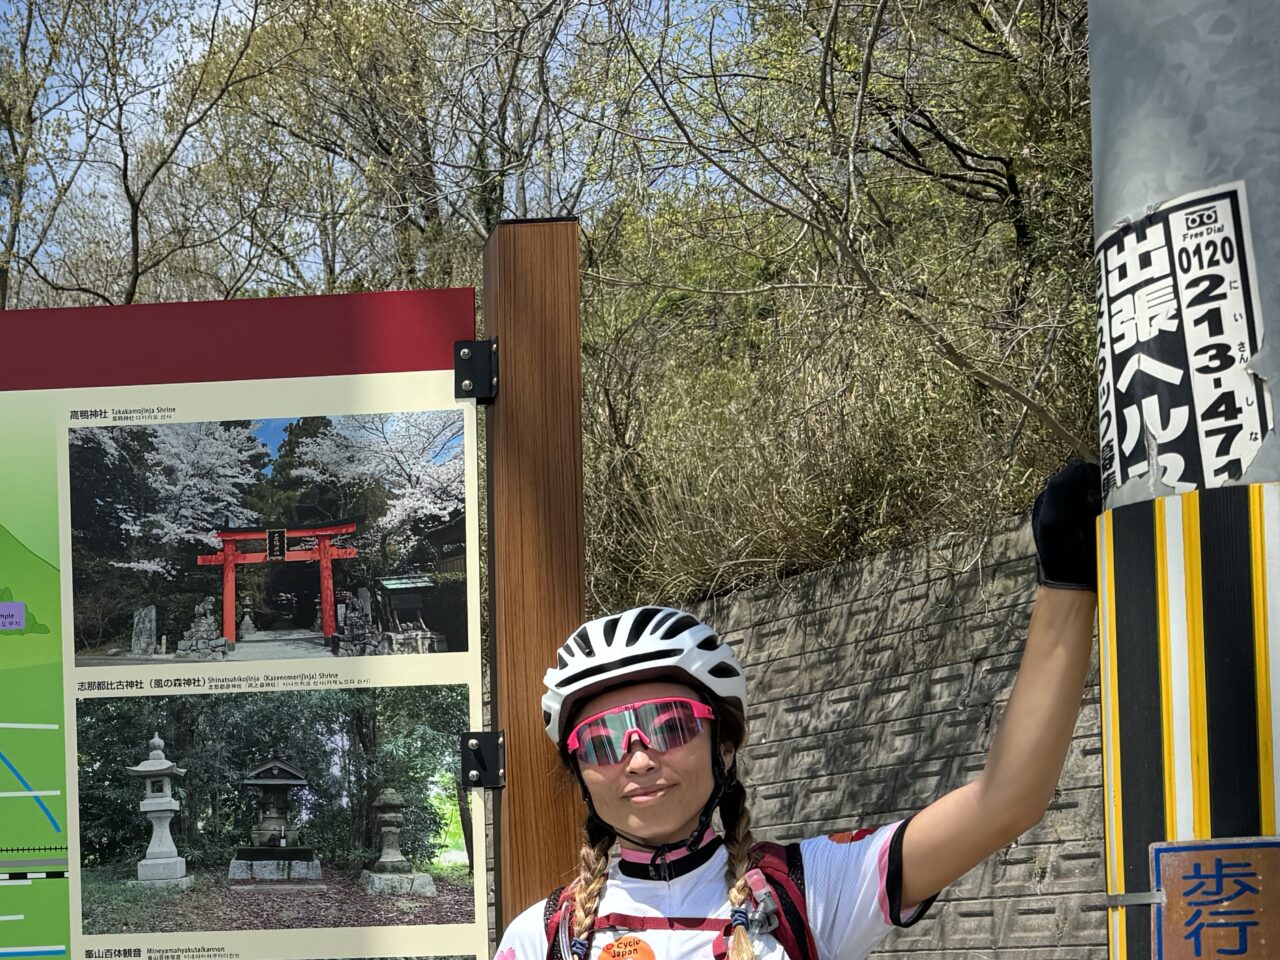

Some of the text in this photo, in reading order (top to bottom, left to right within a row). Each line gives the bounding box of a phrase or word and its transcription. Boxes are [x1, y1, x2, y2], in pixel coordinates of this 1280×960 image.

[1183, 225, 1224, 242] Free Dial
[1178, 236, 1234, 274] 0120
[1229, 278, 1239, 291] に
[616, 938, 641, 950] Cycle
[611, 947, 638, 959] Japan
